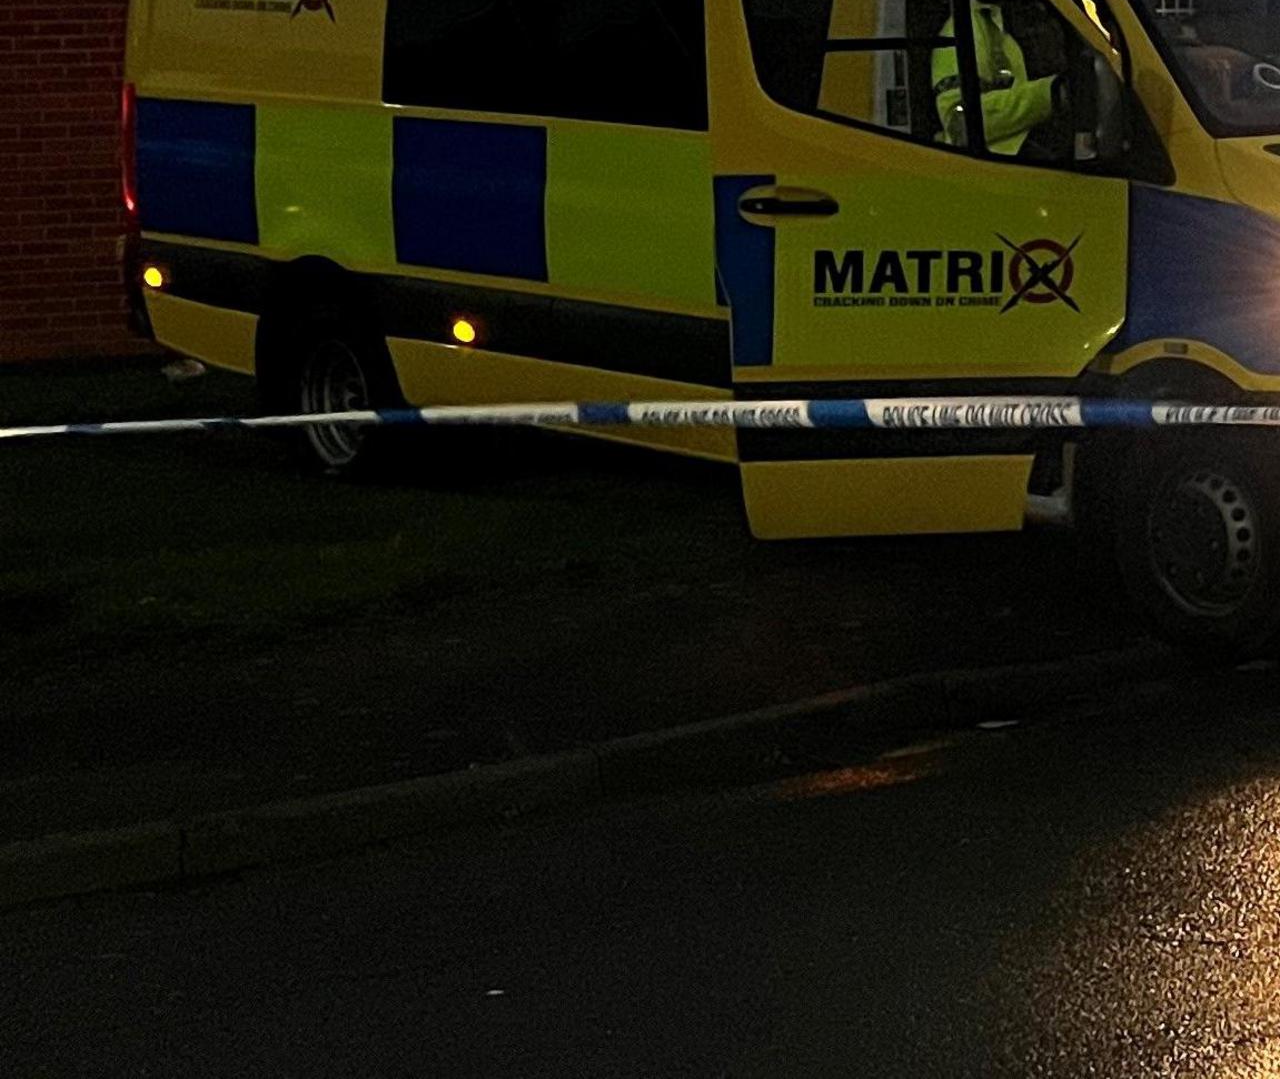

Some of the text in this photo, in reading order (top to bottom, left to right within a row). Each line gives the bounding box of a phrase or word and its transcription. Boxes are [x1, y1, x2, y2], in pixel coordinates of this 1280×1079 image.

[814, 296, 884, 307] CRACKING
[889, 296, 931, 307] DOWN
[935, 296, 954, 307] ON
